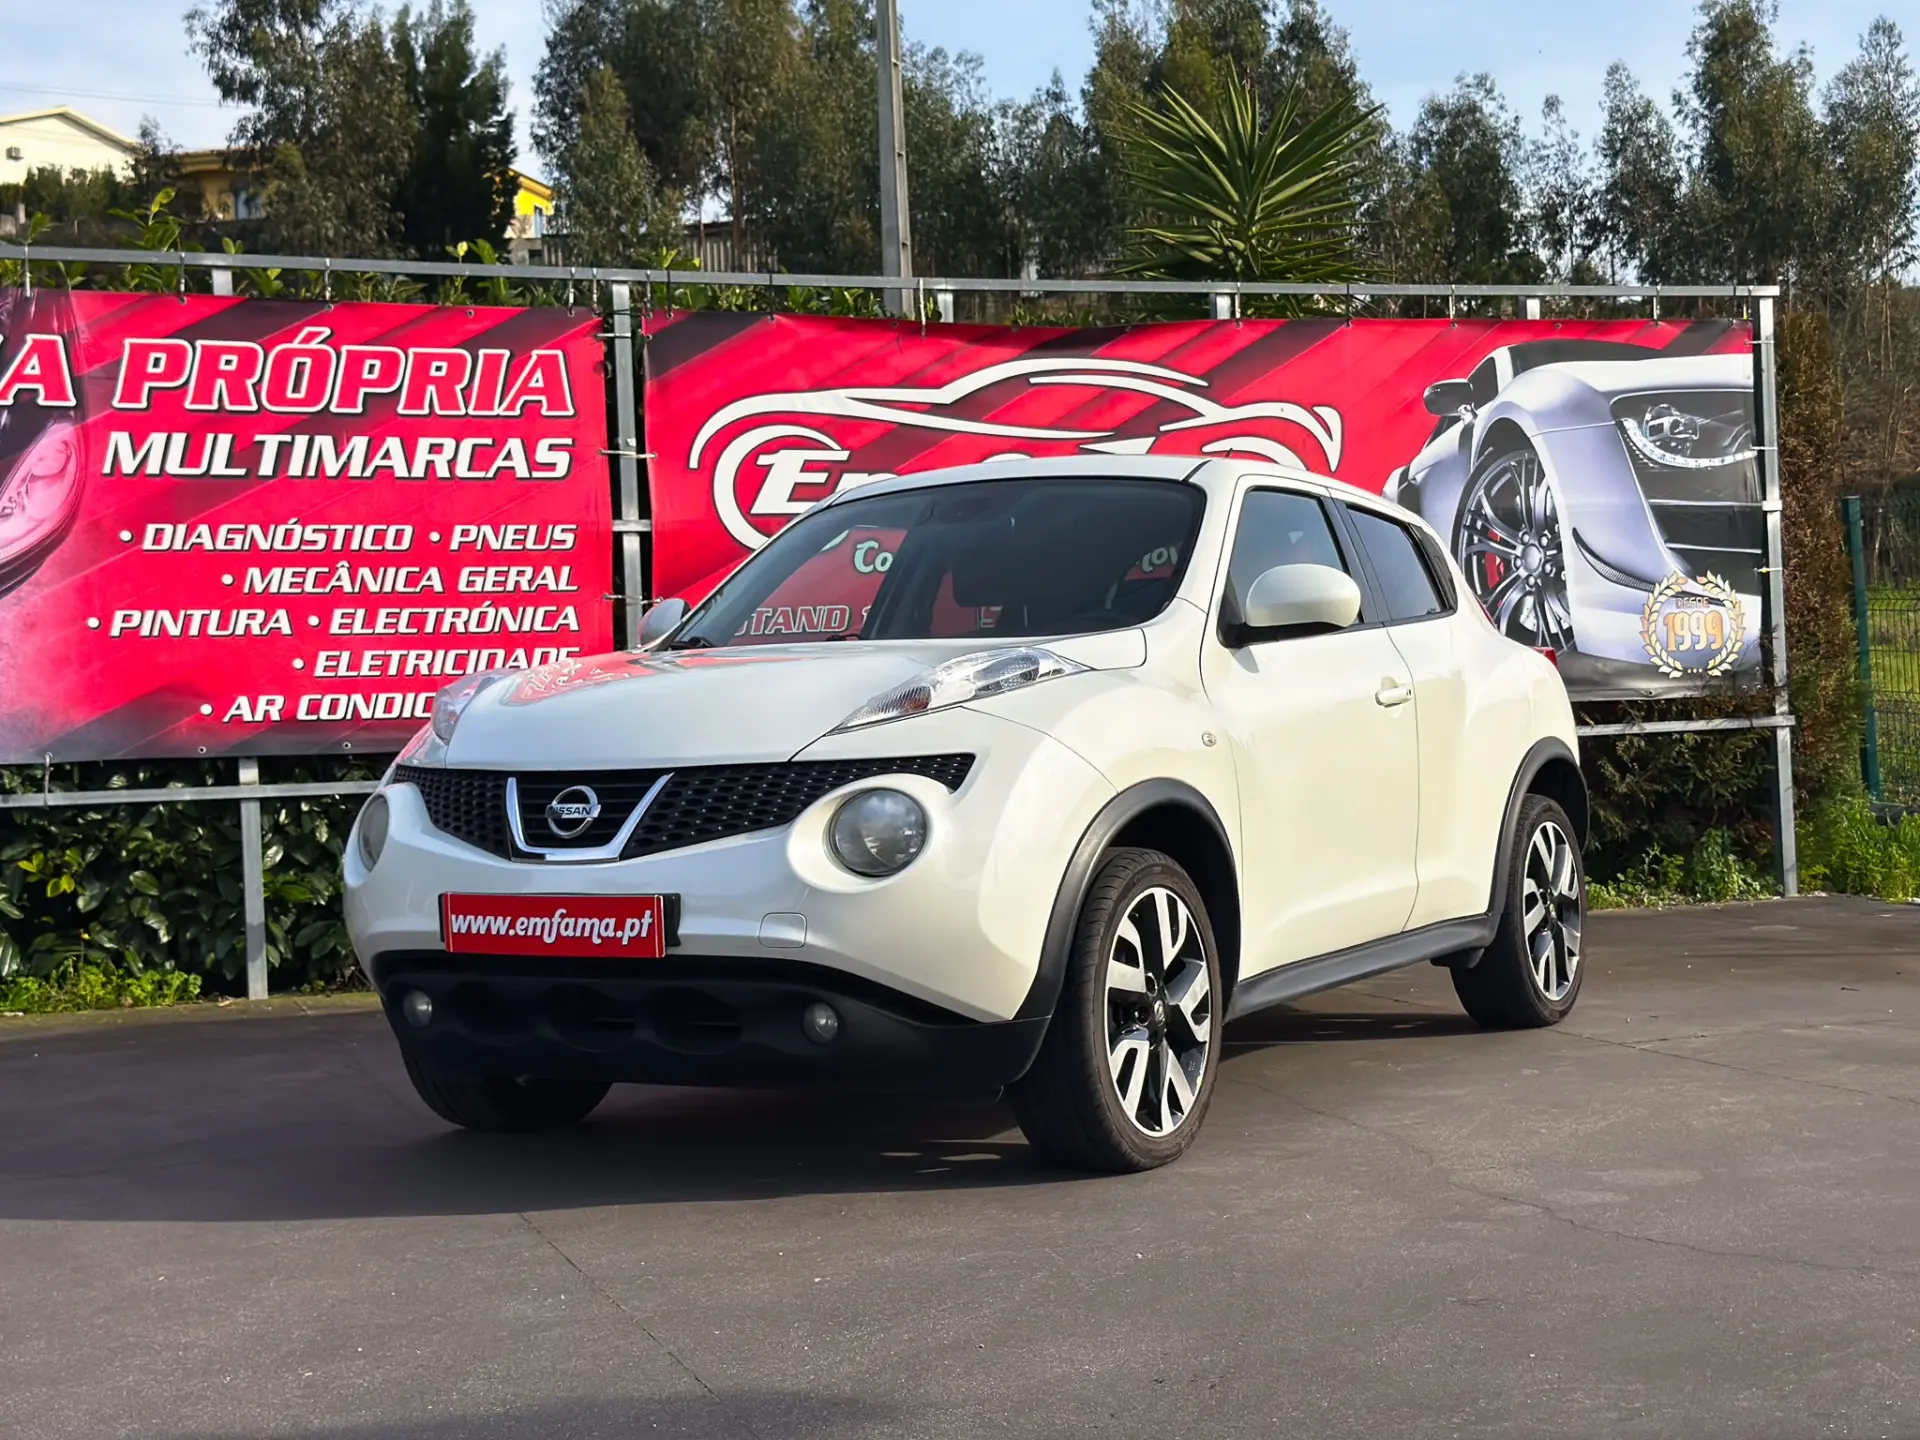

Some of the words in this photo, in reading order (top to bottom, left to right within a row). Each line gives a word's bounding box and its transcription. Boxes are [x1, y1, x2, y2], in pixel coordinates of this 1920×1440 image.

[0, 332, 77, 407] A
[112, 327, 575, 416] PRÓPRIA
[103, 432, 574, 478] MULTIMARCAS
[142, 518, 414, 551] DIAGNÓSTICO
[450, 524, 578, 551] PNEUS
[243, 560, 444, 594] MECÂNICA
[457, 565, 580, 593] GERAL
[109, 609, 292, 637] PINTURA
[329, 600, 580, 635] ELECTRÓNICA
[1663, 610, 1724, 652] 1999
[222, 695, 285, 723] AR
[451, 908, 653, 946] www.emfama.pt
